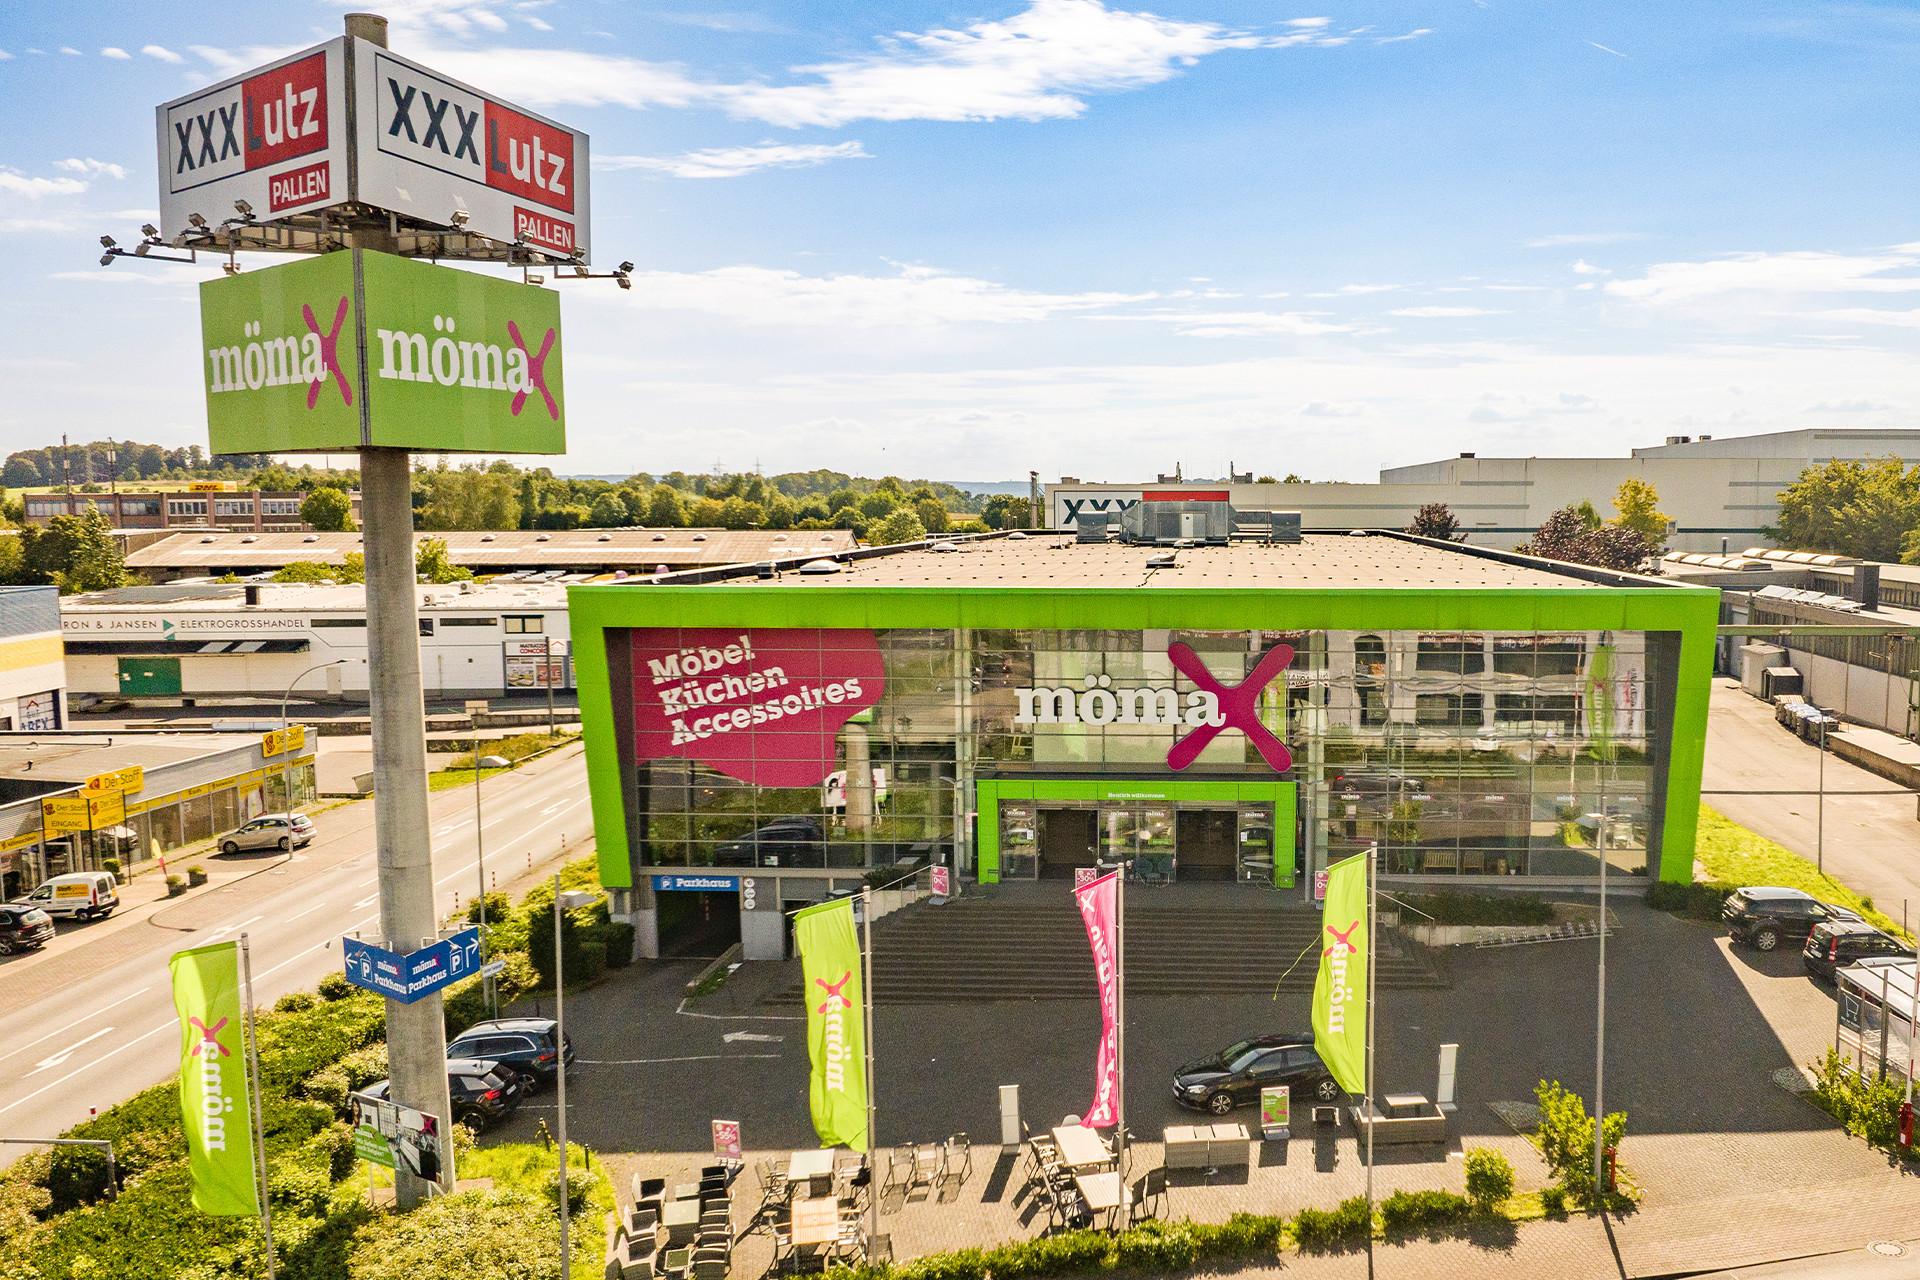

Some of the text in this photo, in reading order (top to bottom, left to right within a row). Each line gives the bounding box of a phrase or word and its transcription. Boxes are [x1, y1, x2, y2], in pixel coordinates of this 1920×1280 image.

[272, 168, 326, 205] PALLEN
[518, 213, 572, 249] PALLEN
[97, 620, 103, 629] &
[110, 620, 157, 629] JANSEN
[180, 619, 304, 629] ELEKTROGROSSHANDEL
[647, 635, 755, 685] Möbel
[658, 666, 788, 716] Küchen
[671, 678, 862, 746] Accessoires
[104, 768, 139, 789] Der Stoff
[676, 877, 731, 888] Parkhaus
[374, 973, 407, 995] Parkhaus
[408, 969, 447, 994] Parkhaus
